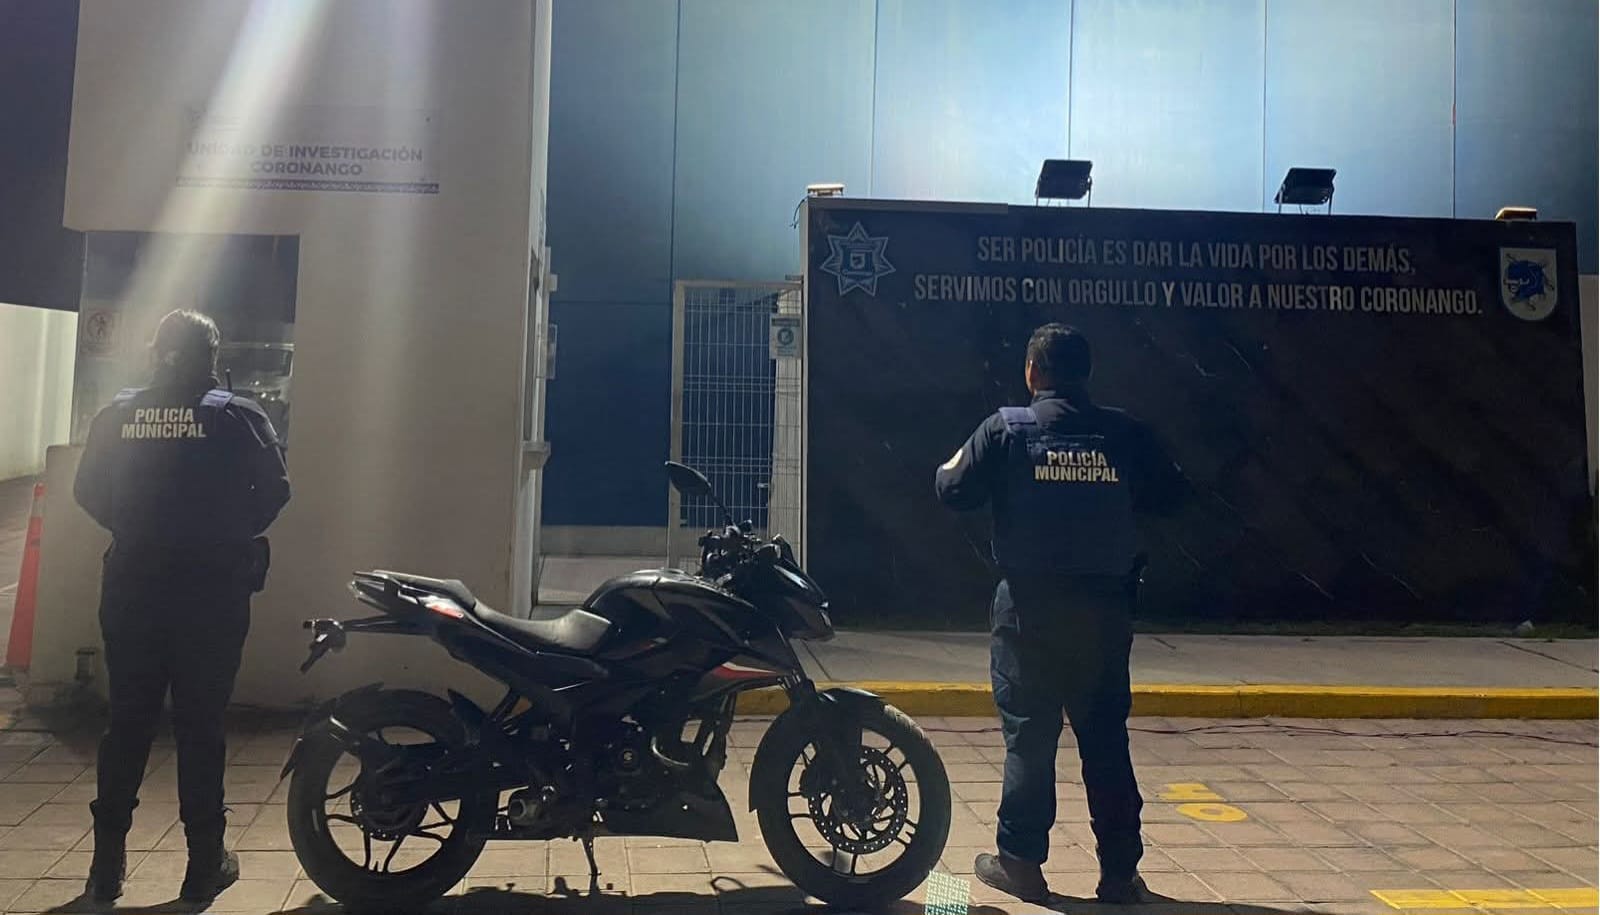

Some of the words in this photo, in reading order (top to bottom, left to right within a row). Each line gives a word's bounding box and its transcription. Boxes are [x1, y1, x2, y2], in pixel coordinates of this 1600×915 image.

[186, 143, 257, 157] UNIAD
[262, 144, 284, 158] DE
[288, 144, 423, 162] INVESTIGACIÓN
[251, 161, 363, 176] CORONANGO
[977, 236, 1015, 262] SER
[1021, 236, 1098, 265] POLICÍA
[1103, 240, 1127, 265] ES
[1133, 241, 1175, 267] DAR
[1179, 242, 1203, 268] LA
[1207, 243, 1254, 270] VIDA
[1259, 245, 1299, 271] POR
[1302, 247, 1338, 272] LOS
[1343, 245, 1416, 275] DEMÁS,
[913, 273, 1017, 302] SERVIMOS
[1022, 278, 1063, 304] CON
[1068, 279, 1157, 306] ORGULLO
[1161, 281, 1177, 307] Y
[1181, 282, 1244, 309] VALOR
[1248, 284, 1262, 309] A
[1267, 284, 1355, 311] NUESTRO
[1360, 286, 1483, 315] CORONANGO.
[134, 405, 195, 424] POLICÍA
[121, 423, 207, 439] MUNICIPAL
[1046, 449, 1108, 467] POLICÍA
[1034, 465, 1120, 483] MUNICIPAL
